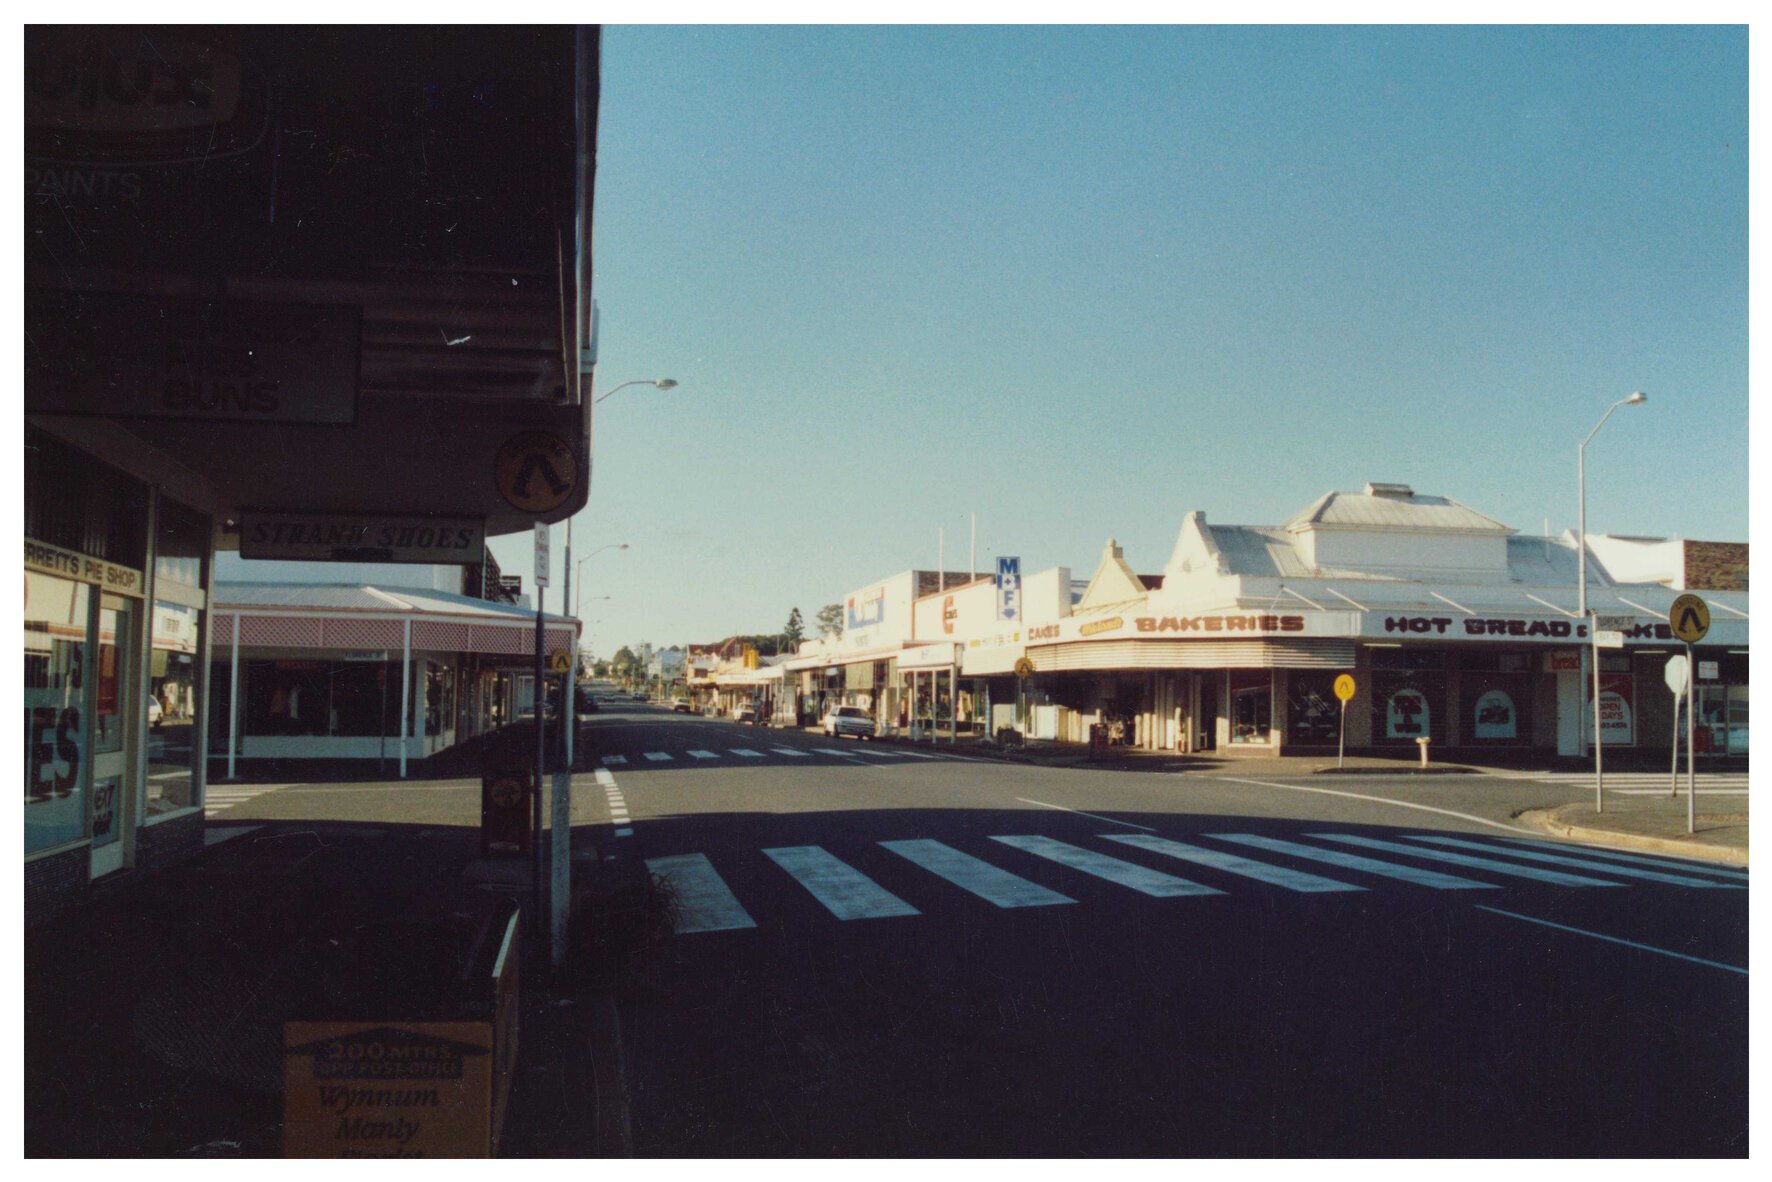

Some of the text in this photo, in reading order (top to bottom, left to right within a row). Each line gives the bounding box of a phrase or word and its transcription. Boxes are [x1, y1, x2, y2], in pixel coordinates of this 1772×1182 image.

[252, 521, 475, 550] STRAND SHOES
[107, 565, 136, 588] SHOP
[1028, 624, 1061, 641] CAKES
[1134, 614, 1305, 633] BAKERIES
[1385, 615, 1453, 634] HOT
[1463, 617, 1572, 638] BREAD
[328, 1042, 385, 1060] 200
[319, 1084, 440, 1116] Wynnum
[334, 1116, 421, 1145] Manly
